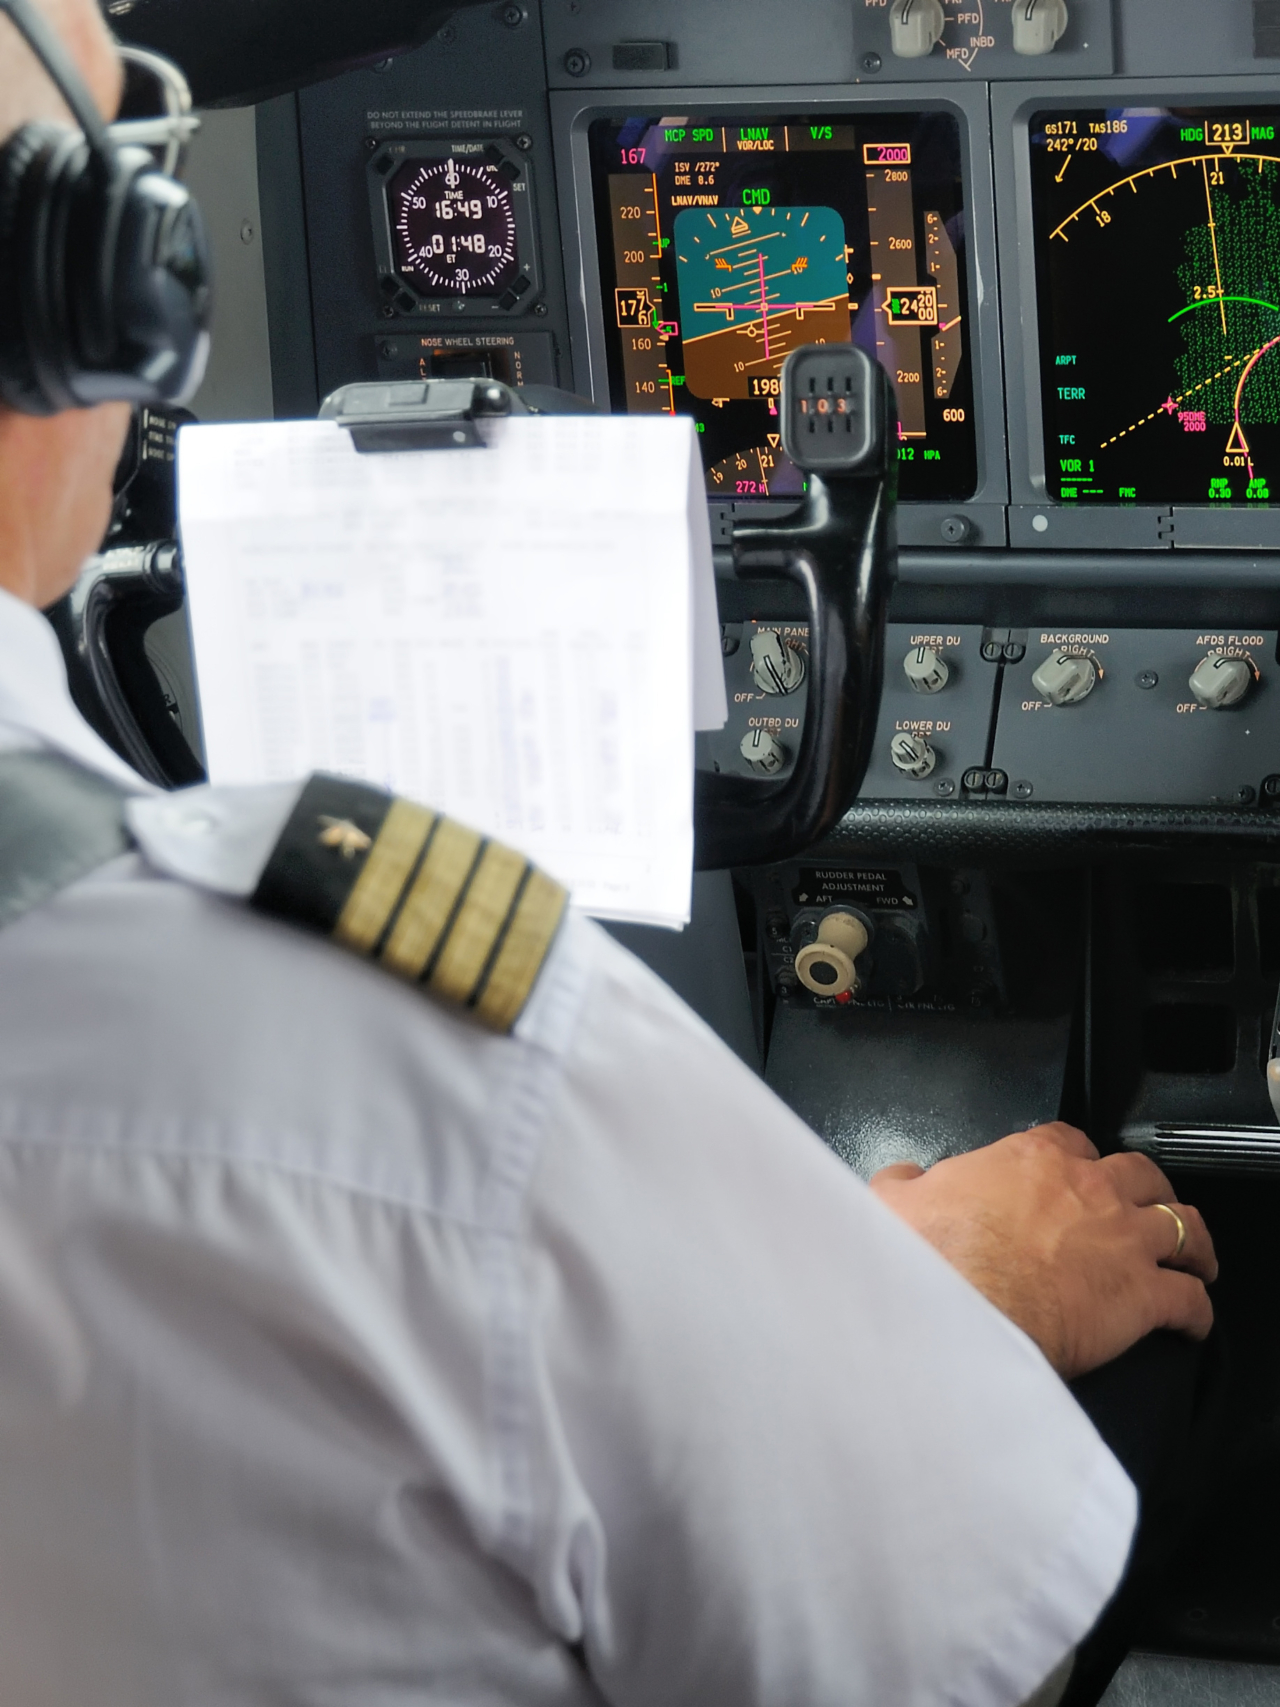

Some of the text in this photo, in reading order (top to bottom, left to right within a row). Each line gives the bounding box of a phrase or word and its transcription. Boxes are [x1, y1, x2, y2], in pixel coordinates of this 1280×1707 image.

[958, 13, 979, 24] PFD
[970, 36, 994, 48] INBD
[947, 47, 968, 59] MFD
[367, 111, 380, 119] DO
[371, 121, 403, 129] BEYOND
[1045, 121, 1128, 135] GS171 TAS186
[664, 128, 713, 141] MCP SPD
[740, 127, 769, 142] LNAV
[810, 126, 832, 139] V/S
[1180, 123, 1275, 141] HDG 213 MAG
[452, 144, 484, 153] TIME/DATE
[737, 141, 774, 151] VOR/LOC
[1047, 138, 1097, 151] 242°/20
[621, 148, 646, 164] 167
[878, 147, 908, 162] 2000
[513, 183, 525, 191] SET
[445, 191, 463, 199] TIME
[672, 195, 718, 206] LNAV/VNAV
[741, 187, 771, 206] CMD
[436, 200, 482, 219] 16:49
[1193, 286, 1216, 298] 2.5
[421, 337, 514, 346] NOSE WHEEL STEERING
[1056, 355, 1076, 365] ARPT
[1058, 388, 1085, 399] TERR
[942, 408, 966, 423] 600
[1059, 435, 1075, 444] TFC
[1060, 459, 1096, 472] VOR 1
[909, 635, 960, 646] UPPER DU
[1039, 632, 1110, 645] BACKGROUND
[1196, 635, 1263, 645] AFDS FLOOD
[896, 721, 950, 731] LOWER DU
[814, 870, 887, 881] RUDDER PEDAL
[821, 881, 886, 893] ADJUSTMENT
